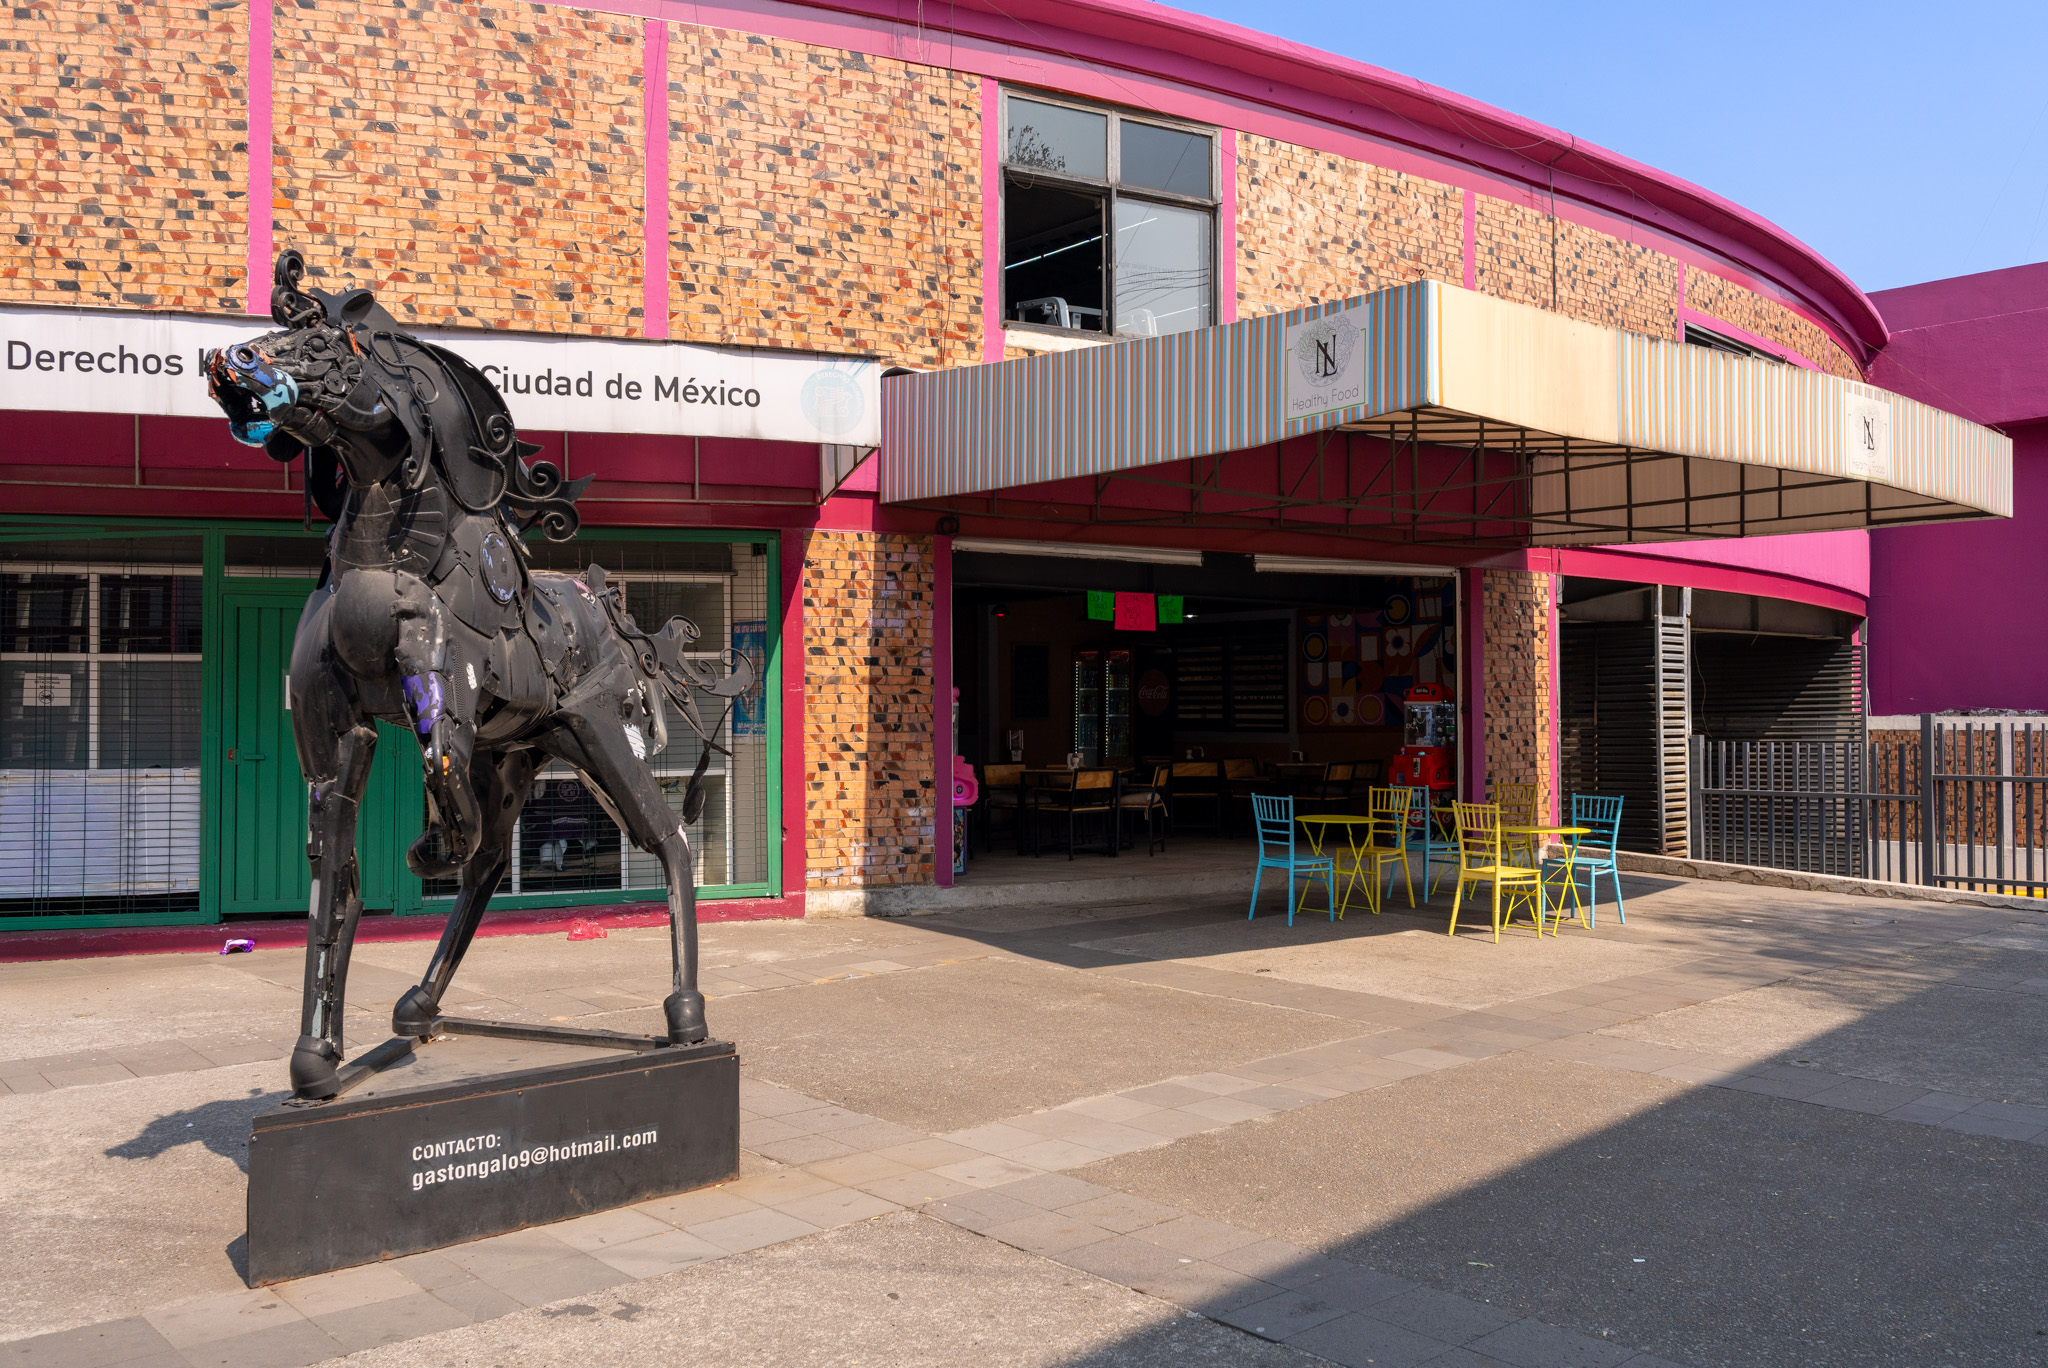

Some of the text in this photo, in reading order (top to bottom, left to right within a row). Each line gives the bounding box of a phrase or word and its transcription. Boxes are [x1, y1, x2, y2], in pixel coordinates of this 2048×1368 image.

[7, 340, 184, 376] Derechos
[605, 373, 642, 400] de
[654, 375, 761, 408] México
[1292, 384, 1359, 411] Healthy Food
[412, 1133, 501, 1161] CONTACTO:
[412, 1130, 657, 1191] gastongalo9@hotmail.com
